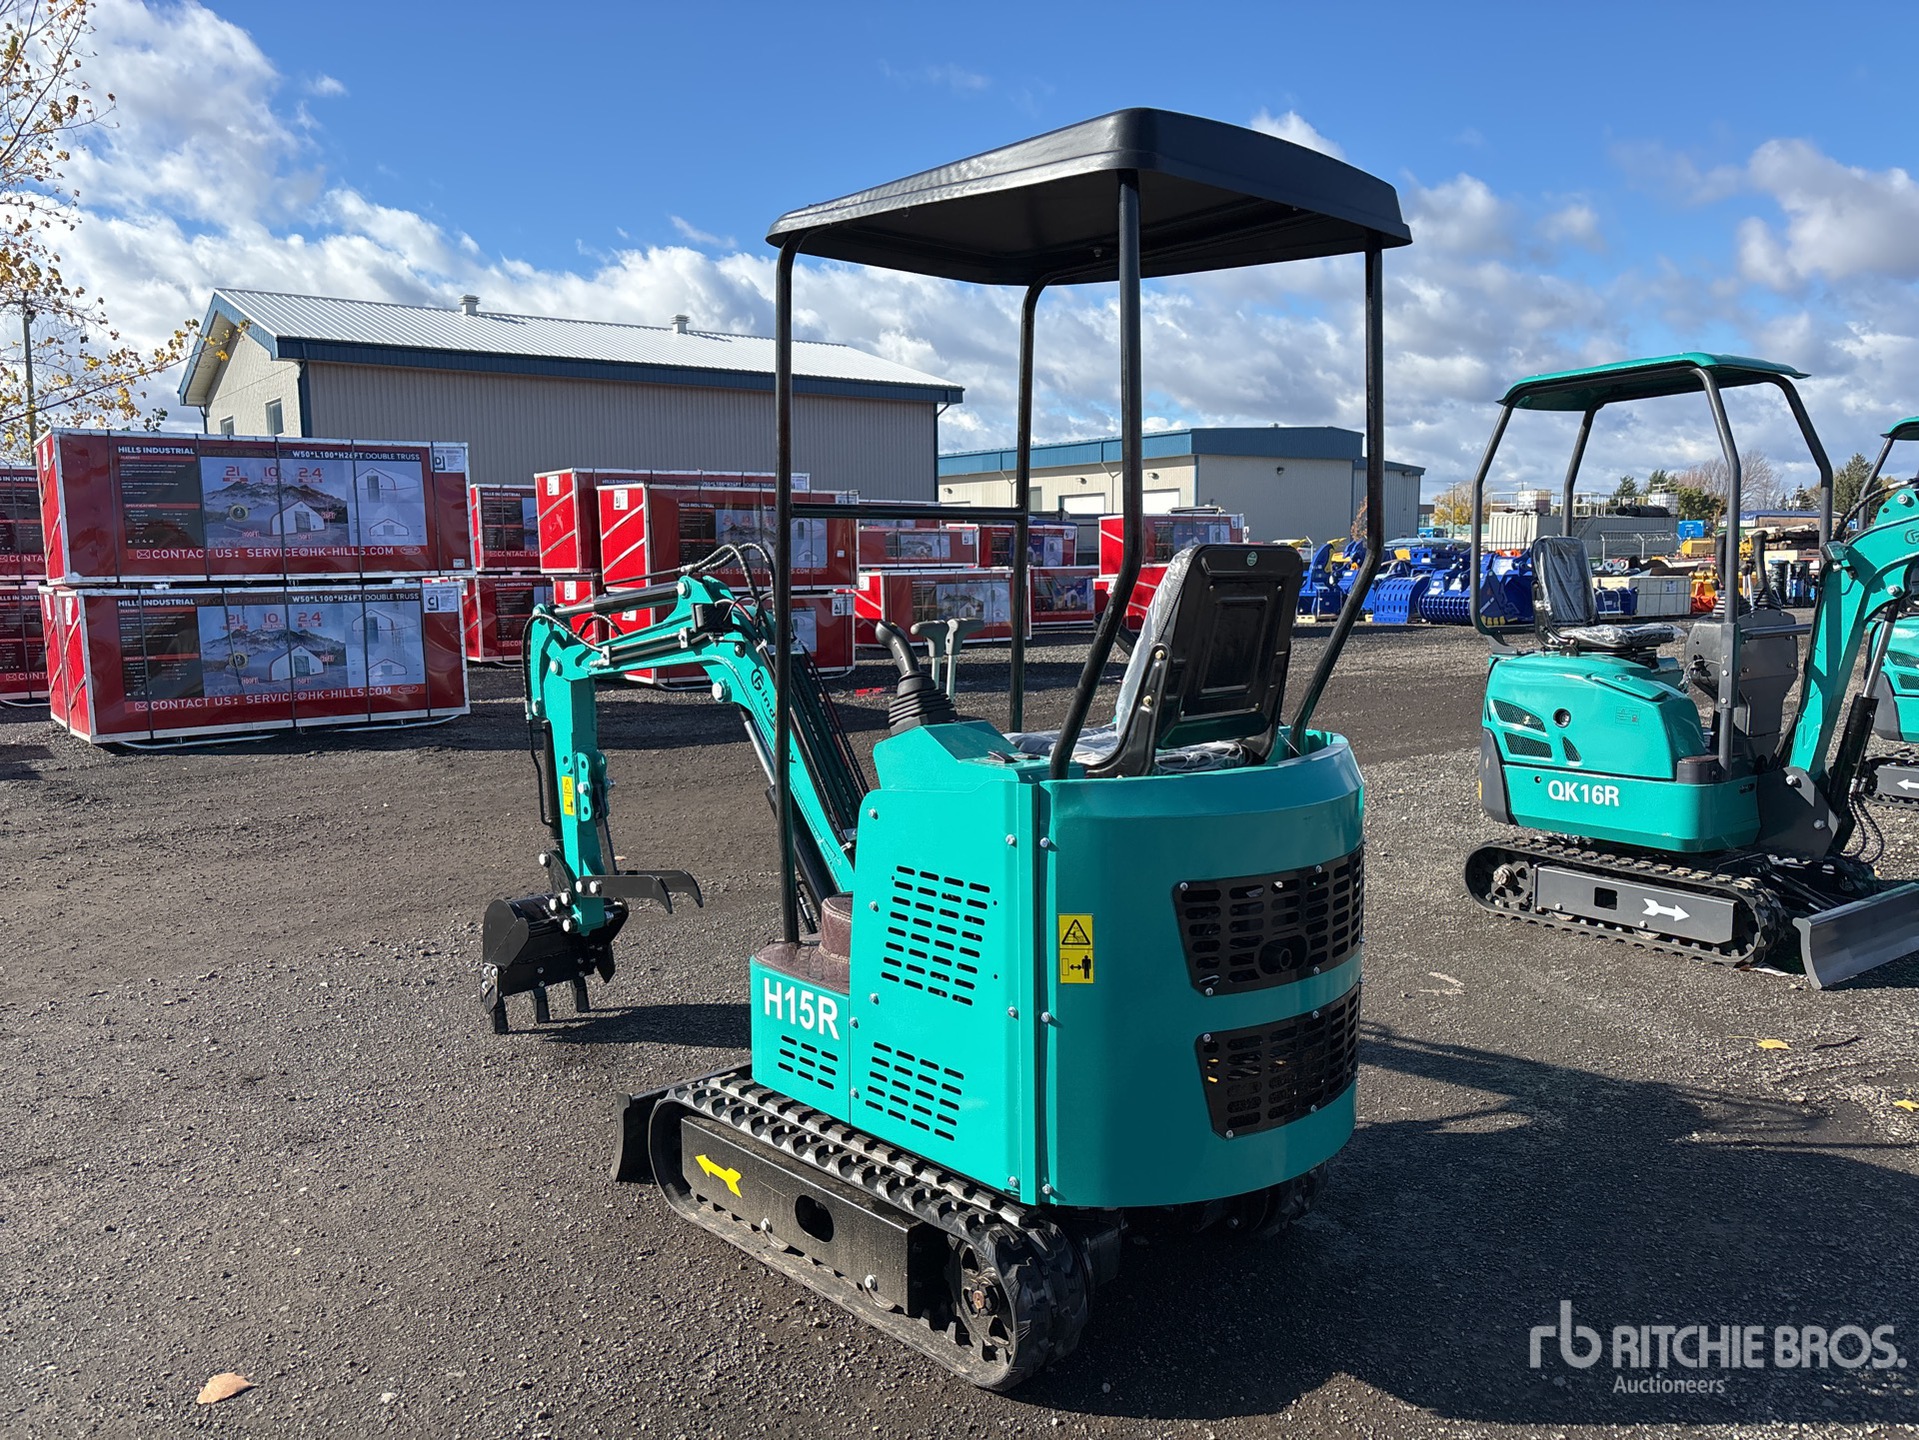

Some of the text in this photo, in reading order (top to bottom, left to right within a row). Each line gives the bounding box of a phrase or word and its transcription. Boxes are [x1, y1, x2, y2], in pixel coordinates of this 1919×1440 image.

[118, 446, 196, 455] HILLS INDUSTRIAL
[366, 452, 395, 460] DOUBLE
[397, 453, 420, 461] TRUSS
[152, 549, 211, 559] CONTACT
[247, 546, 394, 558] SERVICE@HK-HILLS.COM
[263, 613, 278, 624] 10
[246, 686, 392, 705] SERVICE@HK-HILLS.COM
[151, 697, 210, 711] CONTACT
[1547, 780, 1620, 807] QK16R
[764, 977, 840, 1040] H15R
